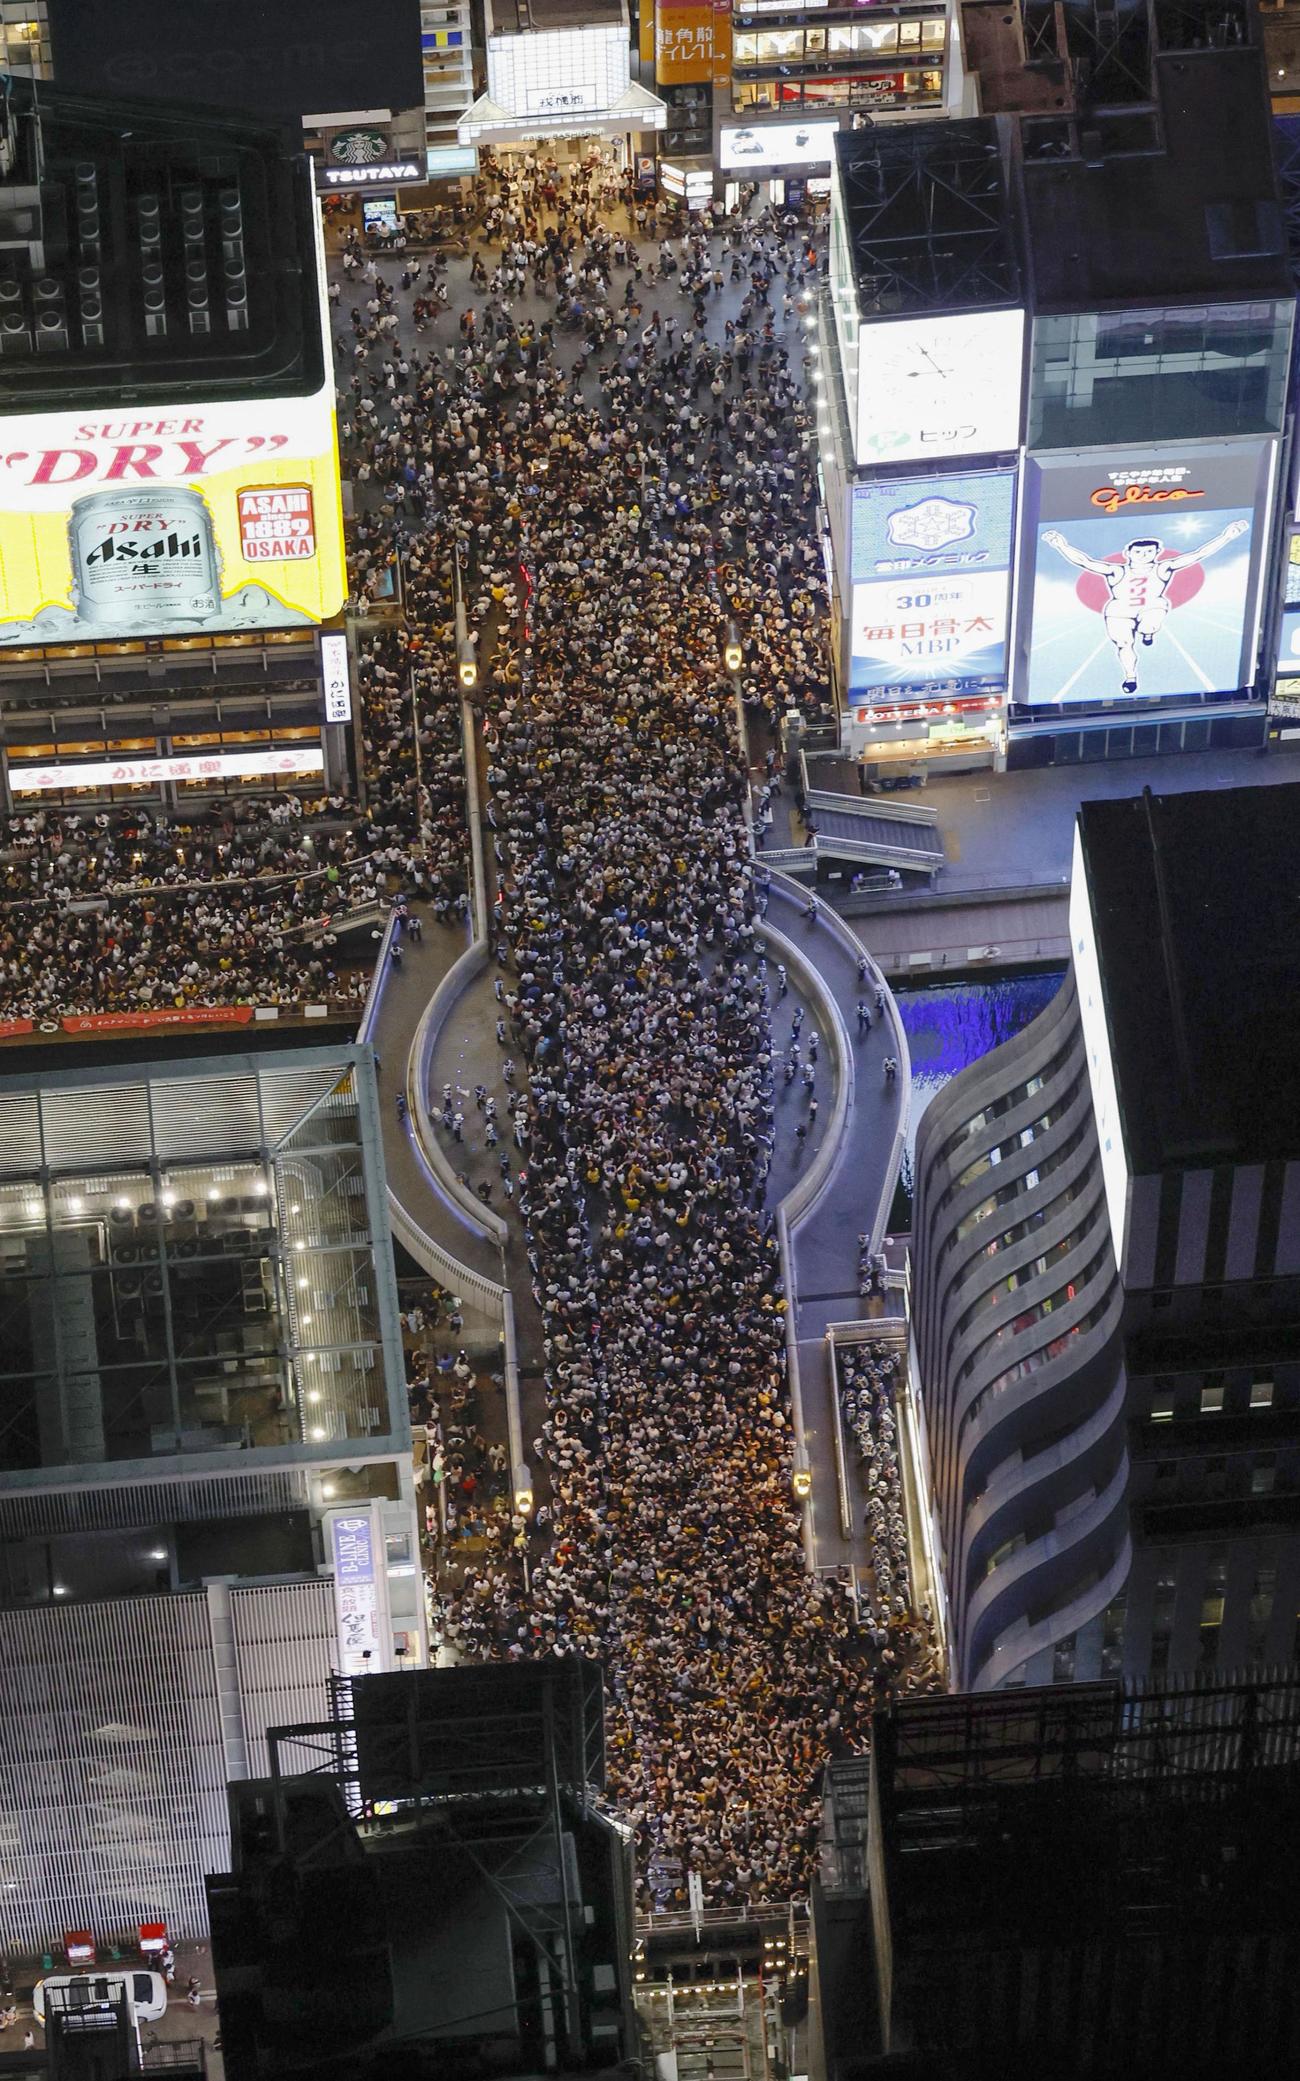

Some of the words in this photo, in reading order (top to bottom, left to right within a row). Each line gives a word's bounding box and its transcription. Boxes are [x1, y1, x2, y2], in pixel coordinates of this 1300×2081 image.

[829, 27, 897, 51] NY
[326, 164, 420, 183] TSUTAYA
[74, 418, 205, 441] SUPER
[242, 494, 309, 515] ASAHI
[243, 518, 310, 539] 1889
[86, 532, 201, 566] Asahi
[247, 539, 310, 558] OSAKA
[132, 563, 160, 575] 生
[114, 582, 182, 592] スーパードライ
[192, 598, 215, 609] お酒
[863, 616, 995, 641] 毎日骨太
[901, 638, 960, 656] MBP
[339, 1534, 358, 1574] B-LINE
